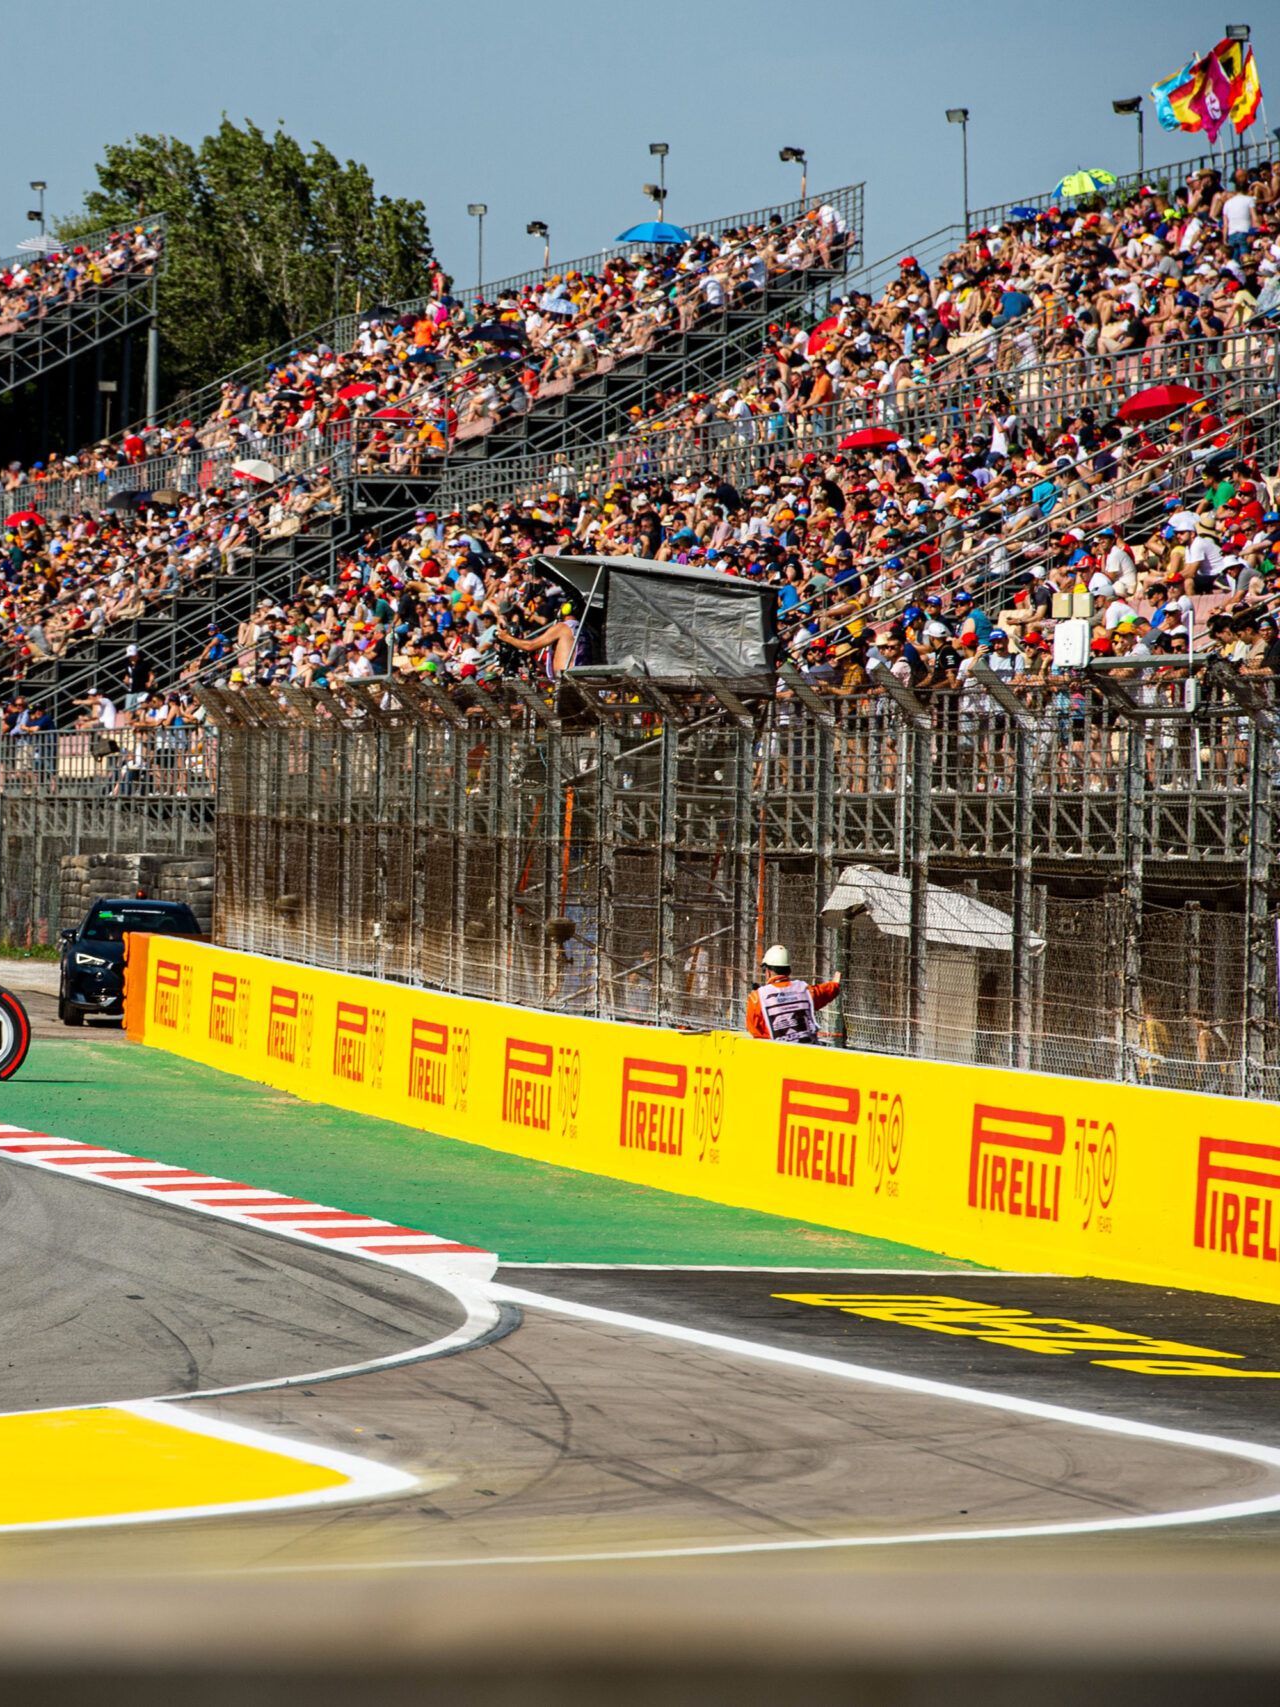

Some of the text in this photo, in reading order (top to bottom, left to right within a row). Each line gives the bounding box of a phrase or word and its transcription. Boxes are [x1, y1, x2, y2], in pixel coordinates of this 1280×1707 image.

[153, 959, 181, 1030] PIRELLI
[209, 971, 237, 1045] PIRELLI
[267, 986, 298, 1064] PIRELLI
[333, 1001, 368, 1083] PIRELLI
[408, 1018, 449, 1106] PIRELLI
[502, 1037, 581, 1137] PIRELLI 150
[620, 1057, 725, 1163] PIRELLI 150
[775, 1078, 905, 1195] PIRELLI 150
[967, 1103, 1118, 1231] PIRELLI 150
[1193, 1136, 1280, 1263] PIREL
[770, 1293, 1246, 1359] ZERO
